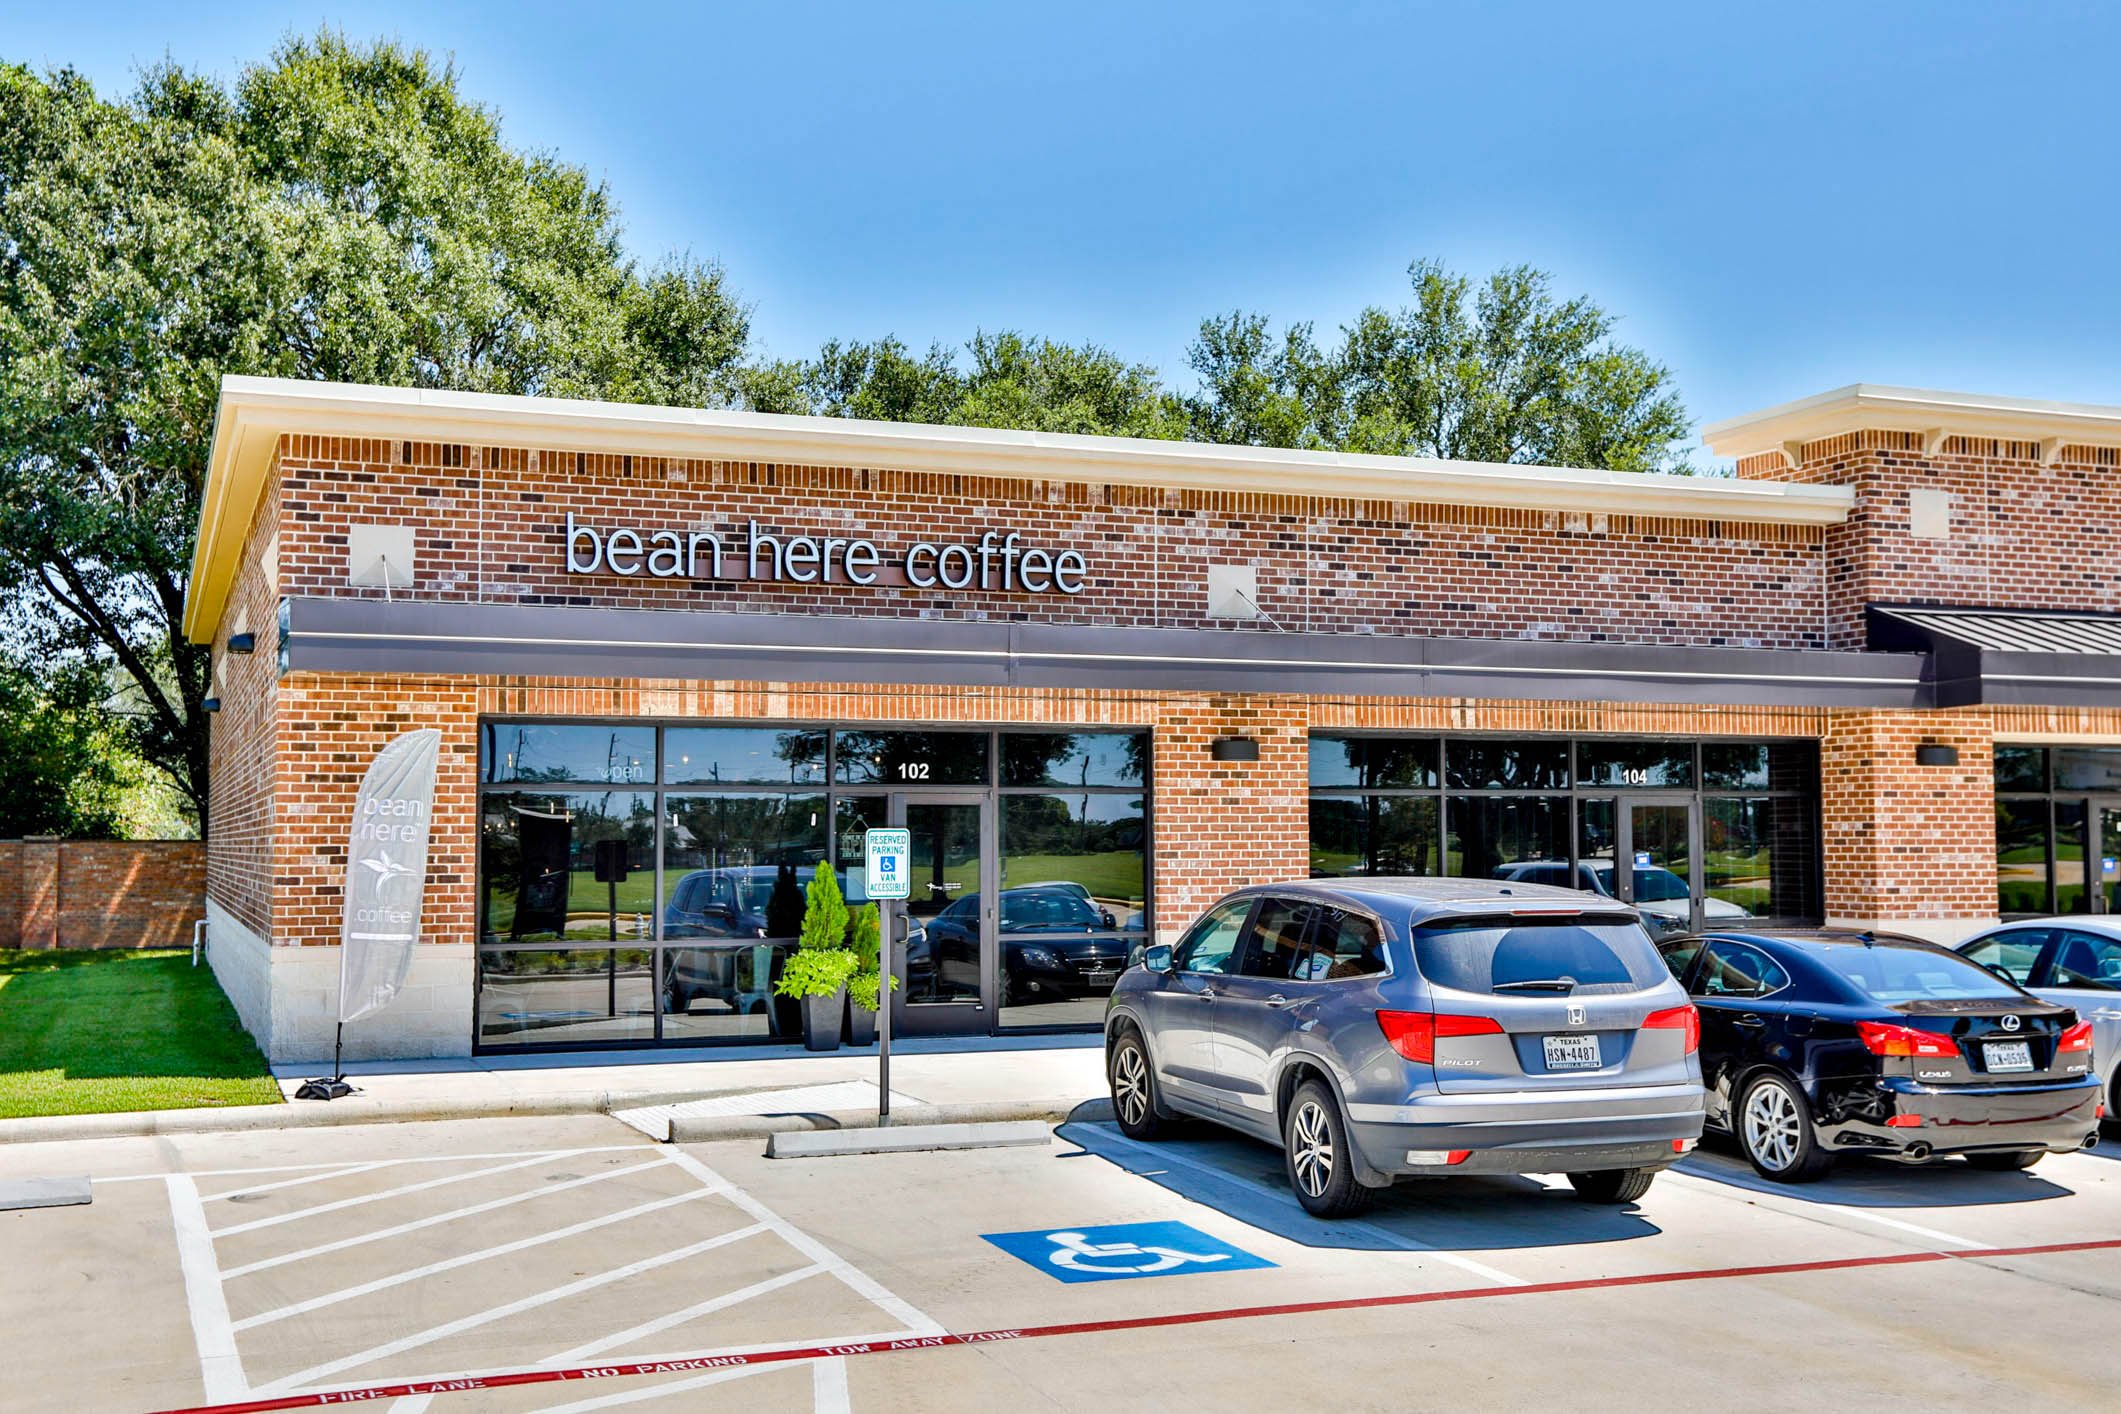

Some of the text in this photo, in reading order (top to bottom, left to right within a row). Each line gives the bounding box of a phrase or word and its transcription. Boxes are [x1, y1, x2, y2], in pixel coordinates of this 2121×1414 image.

[565, 512, 1087, 594] bean here coffee
[898, 763, 930, 779] 102
[1622, 768, 1648, 784] 104
[364, 793, 423, 816] bean
[870, 836, 906, 845] RESERVED
[872, 846, 904, 855] PARKING
[880, 873, 896, 882] VAN
[870, 883, 906, 892] ACCESSIBLE
[319, 1330, 1024, 1404] FIRE LANE NO PARKING TOW AWAY ZONE
